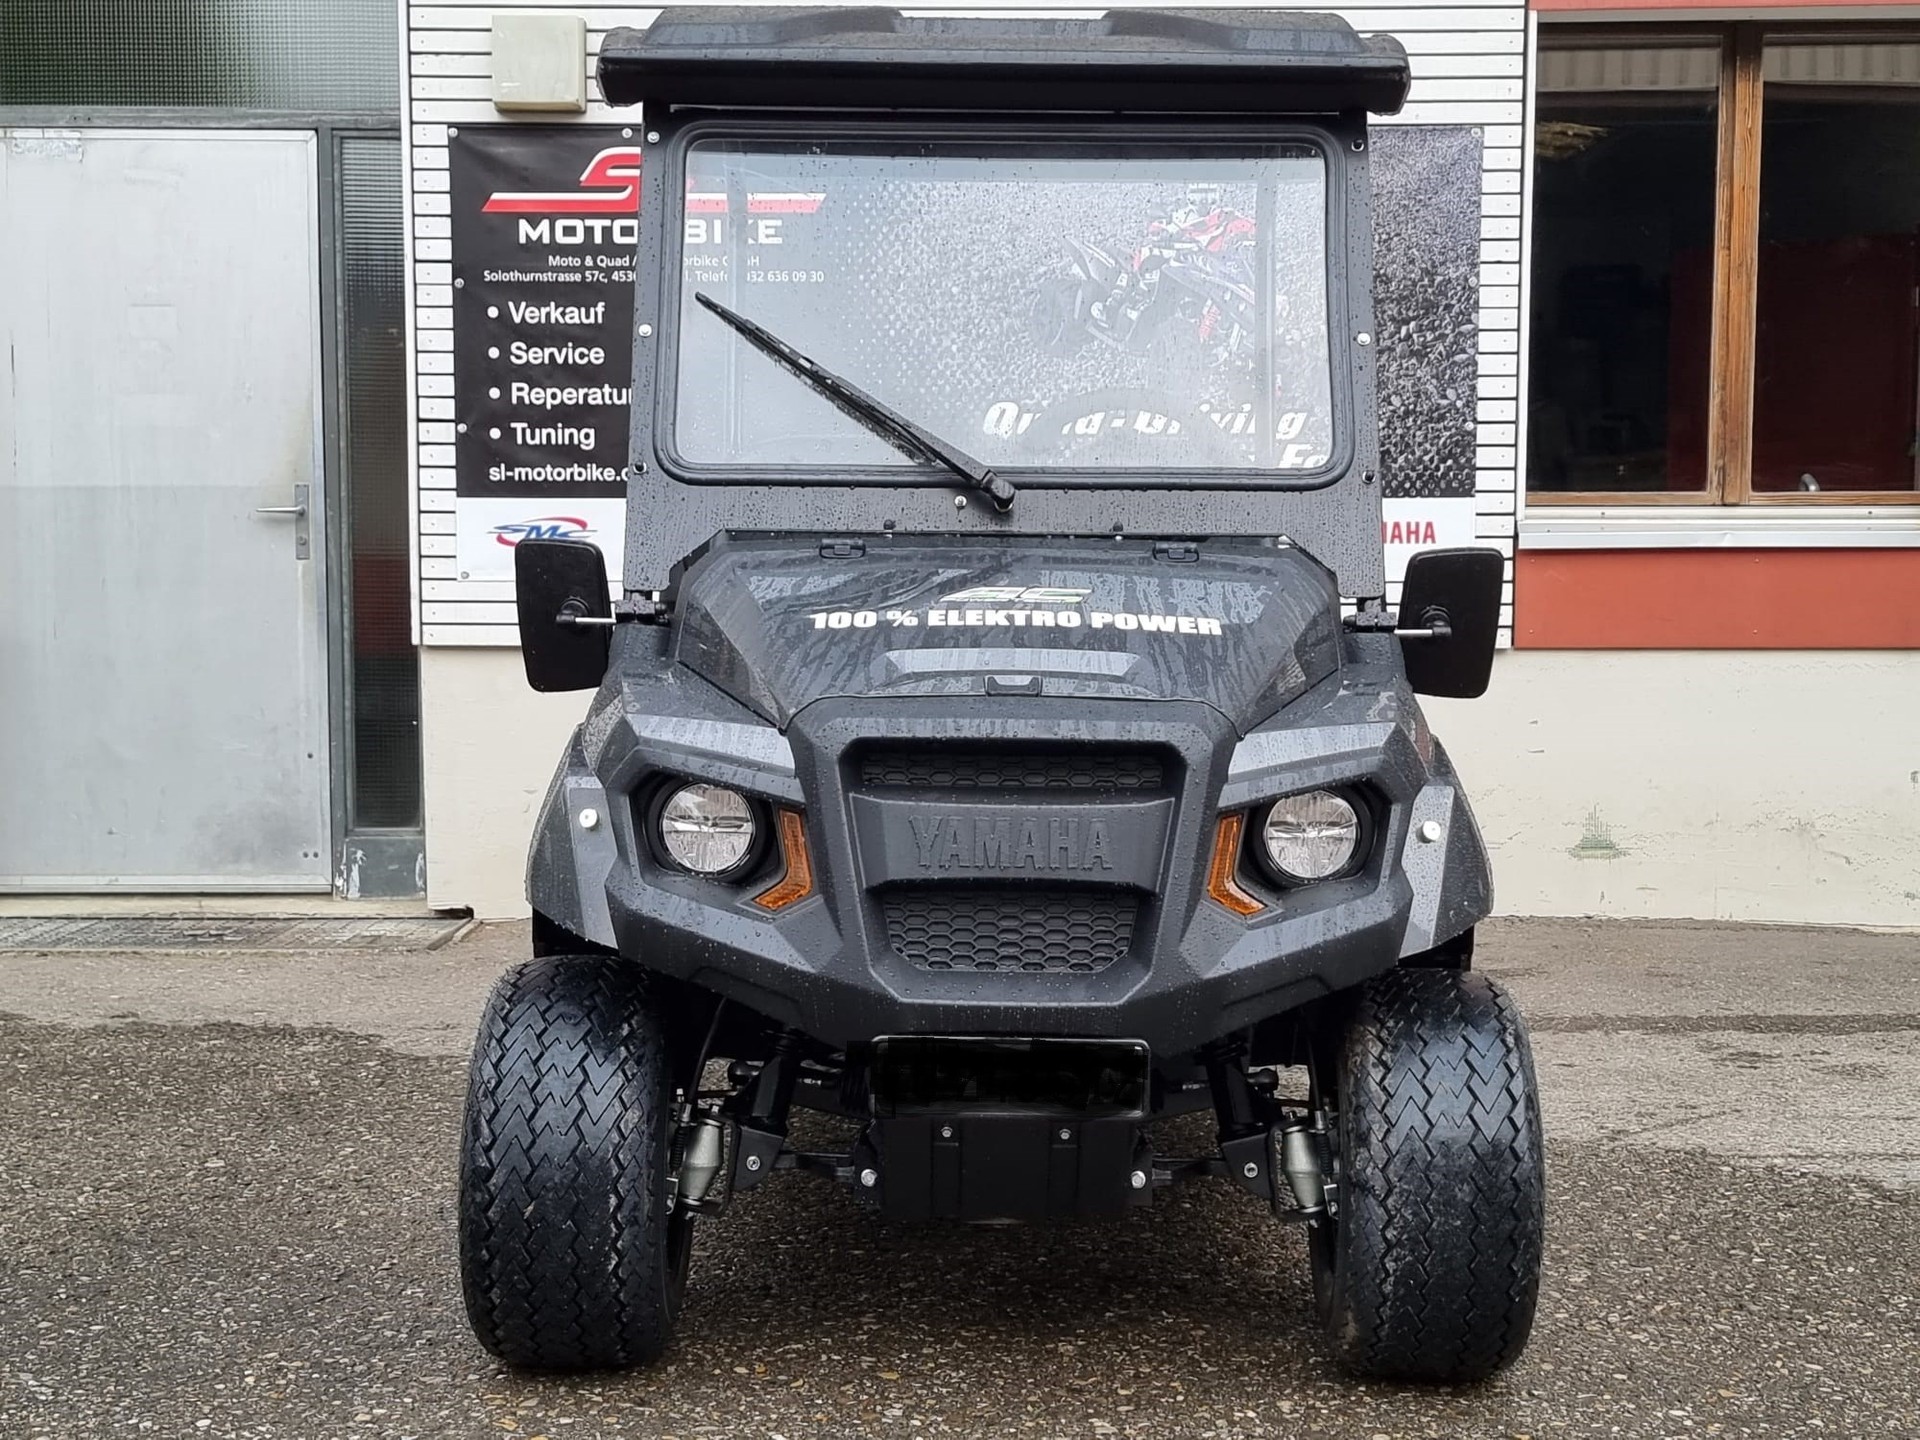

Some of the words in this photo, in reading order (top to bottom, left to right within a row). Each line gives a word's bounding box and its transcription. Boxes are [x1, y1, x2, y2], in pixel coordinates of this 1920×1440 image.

[548, 255, 581, 267] Moto
[585, 255, 594, 267] &
[597, 255, 630, 269] Quad
[483, 269, 582, 283] Solothurnstrasse
[585, 270, 608, 284] 57c,
[747, 271, 764, 283] 32
[792, 271, 807, 283] 09
[809, 271, 825, 283] 30
[508, 301, 606, 324] Verkauf
[509, 342, 606, 365] Service
[510, 422, 595, 450] Tuning
[488, 463, 629, 482] sl-motorbike.c
[1382, 521, 1437, 545] AHA
[809, 610, 877, 629] 100
[886, 610, 919, 627] %
[927, 609, 1082, 628] ELEKTRO
[1090, 611, 1222, 635] POWER
[908, 815, 1113, 871] YAMAHA
